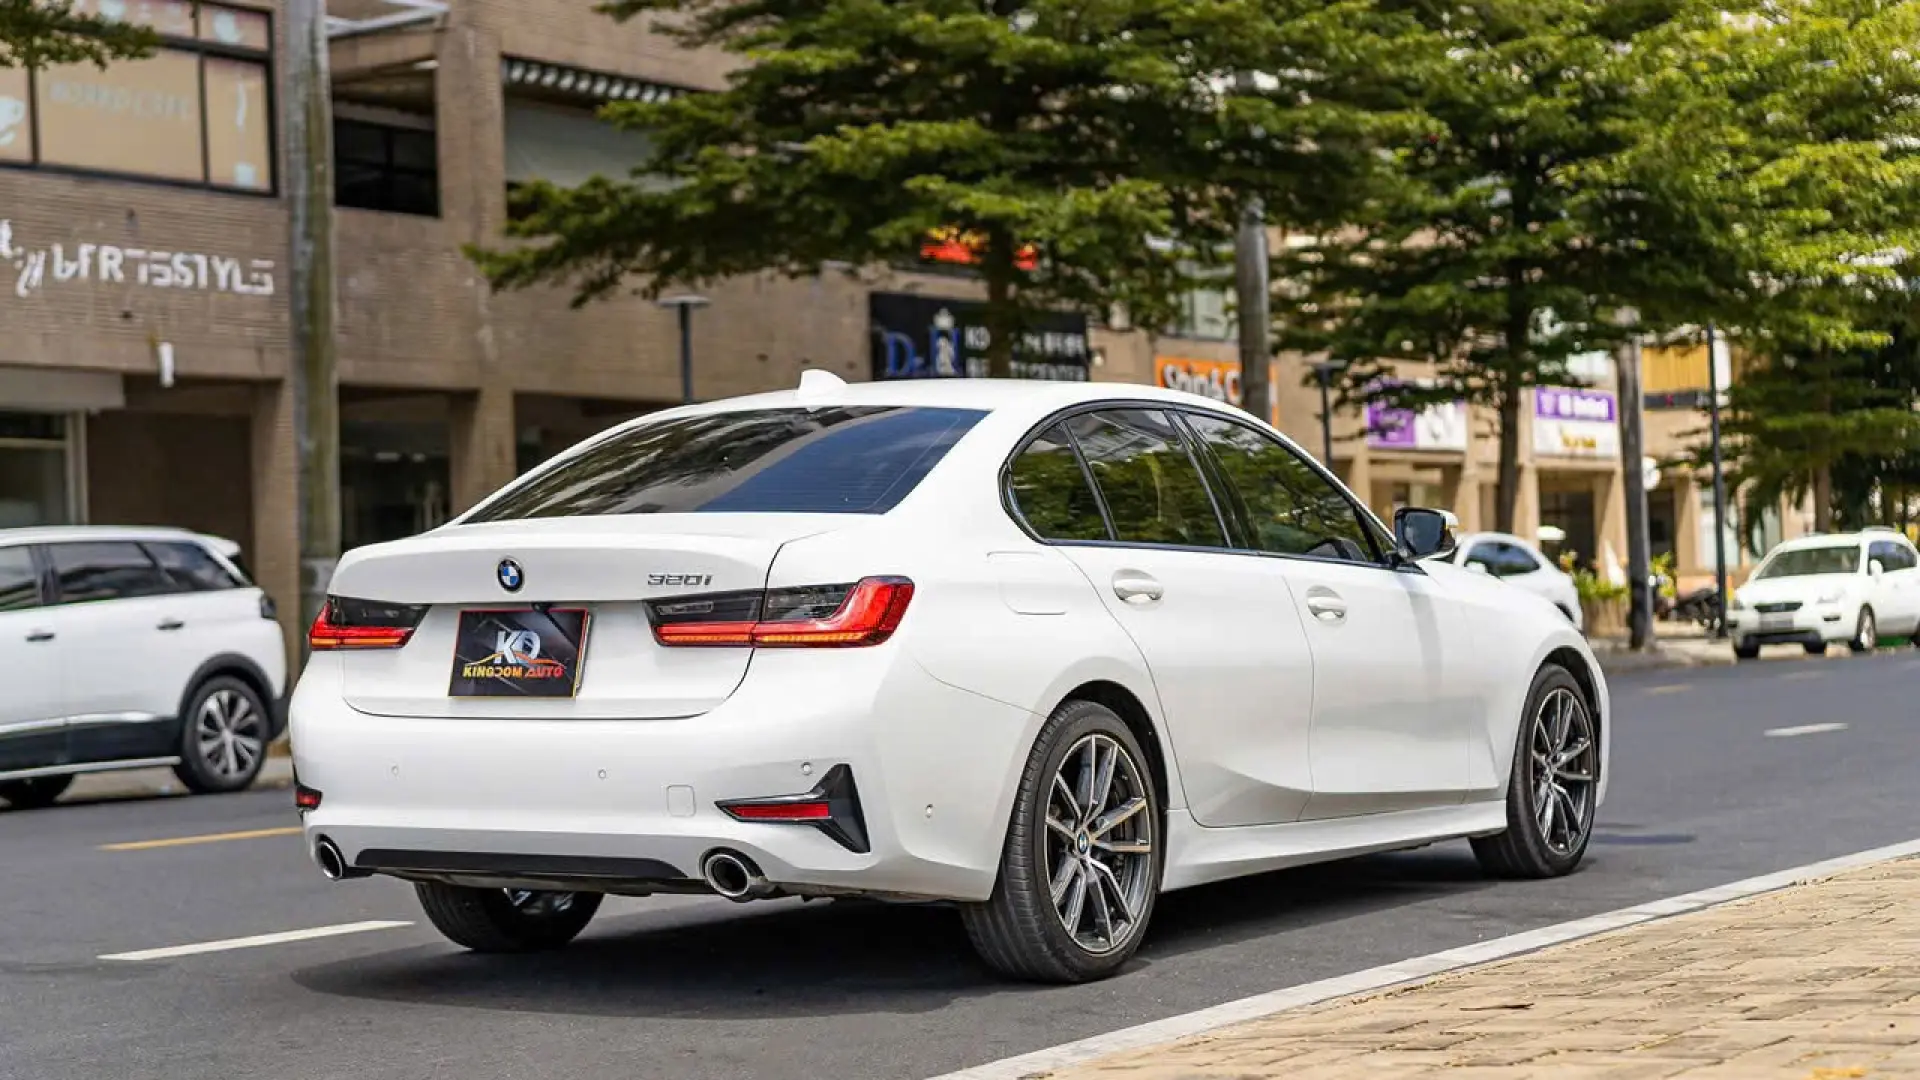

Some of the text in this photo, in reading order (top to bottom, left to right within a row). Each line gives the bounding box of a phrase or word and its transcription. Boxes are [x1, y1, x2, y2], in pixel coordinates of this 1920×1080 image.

[647, 573, 713, 586] 320i
[462, 665, 565, 678] KINGDOM AUTO
